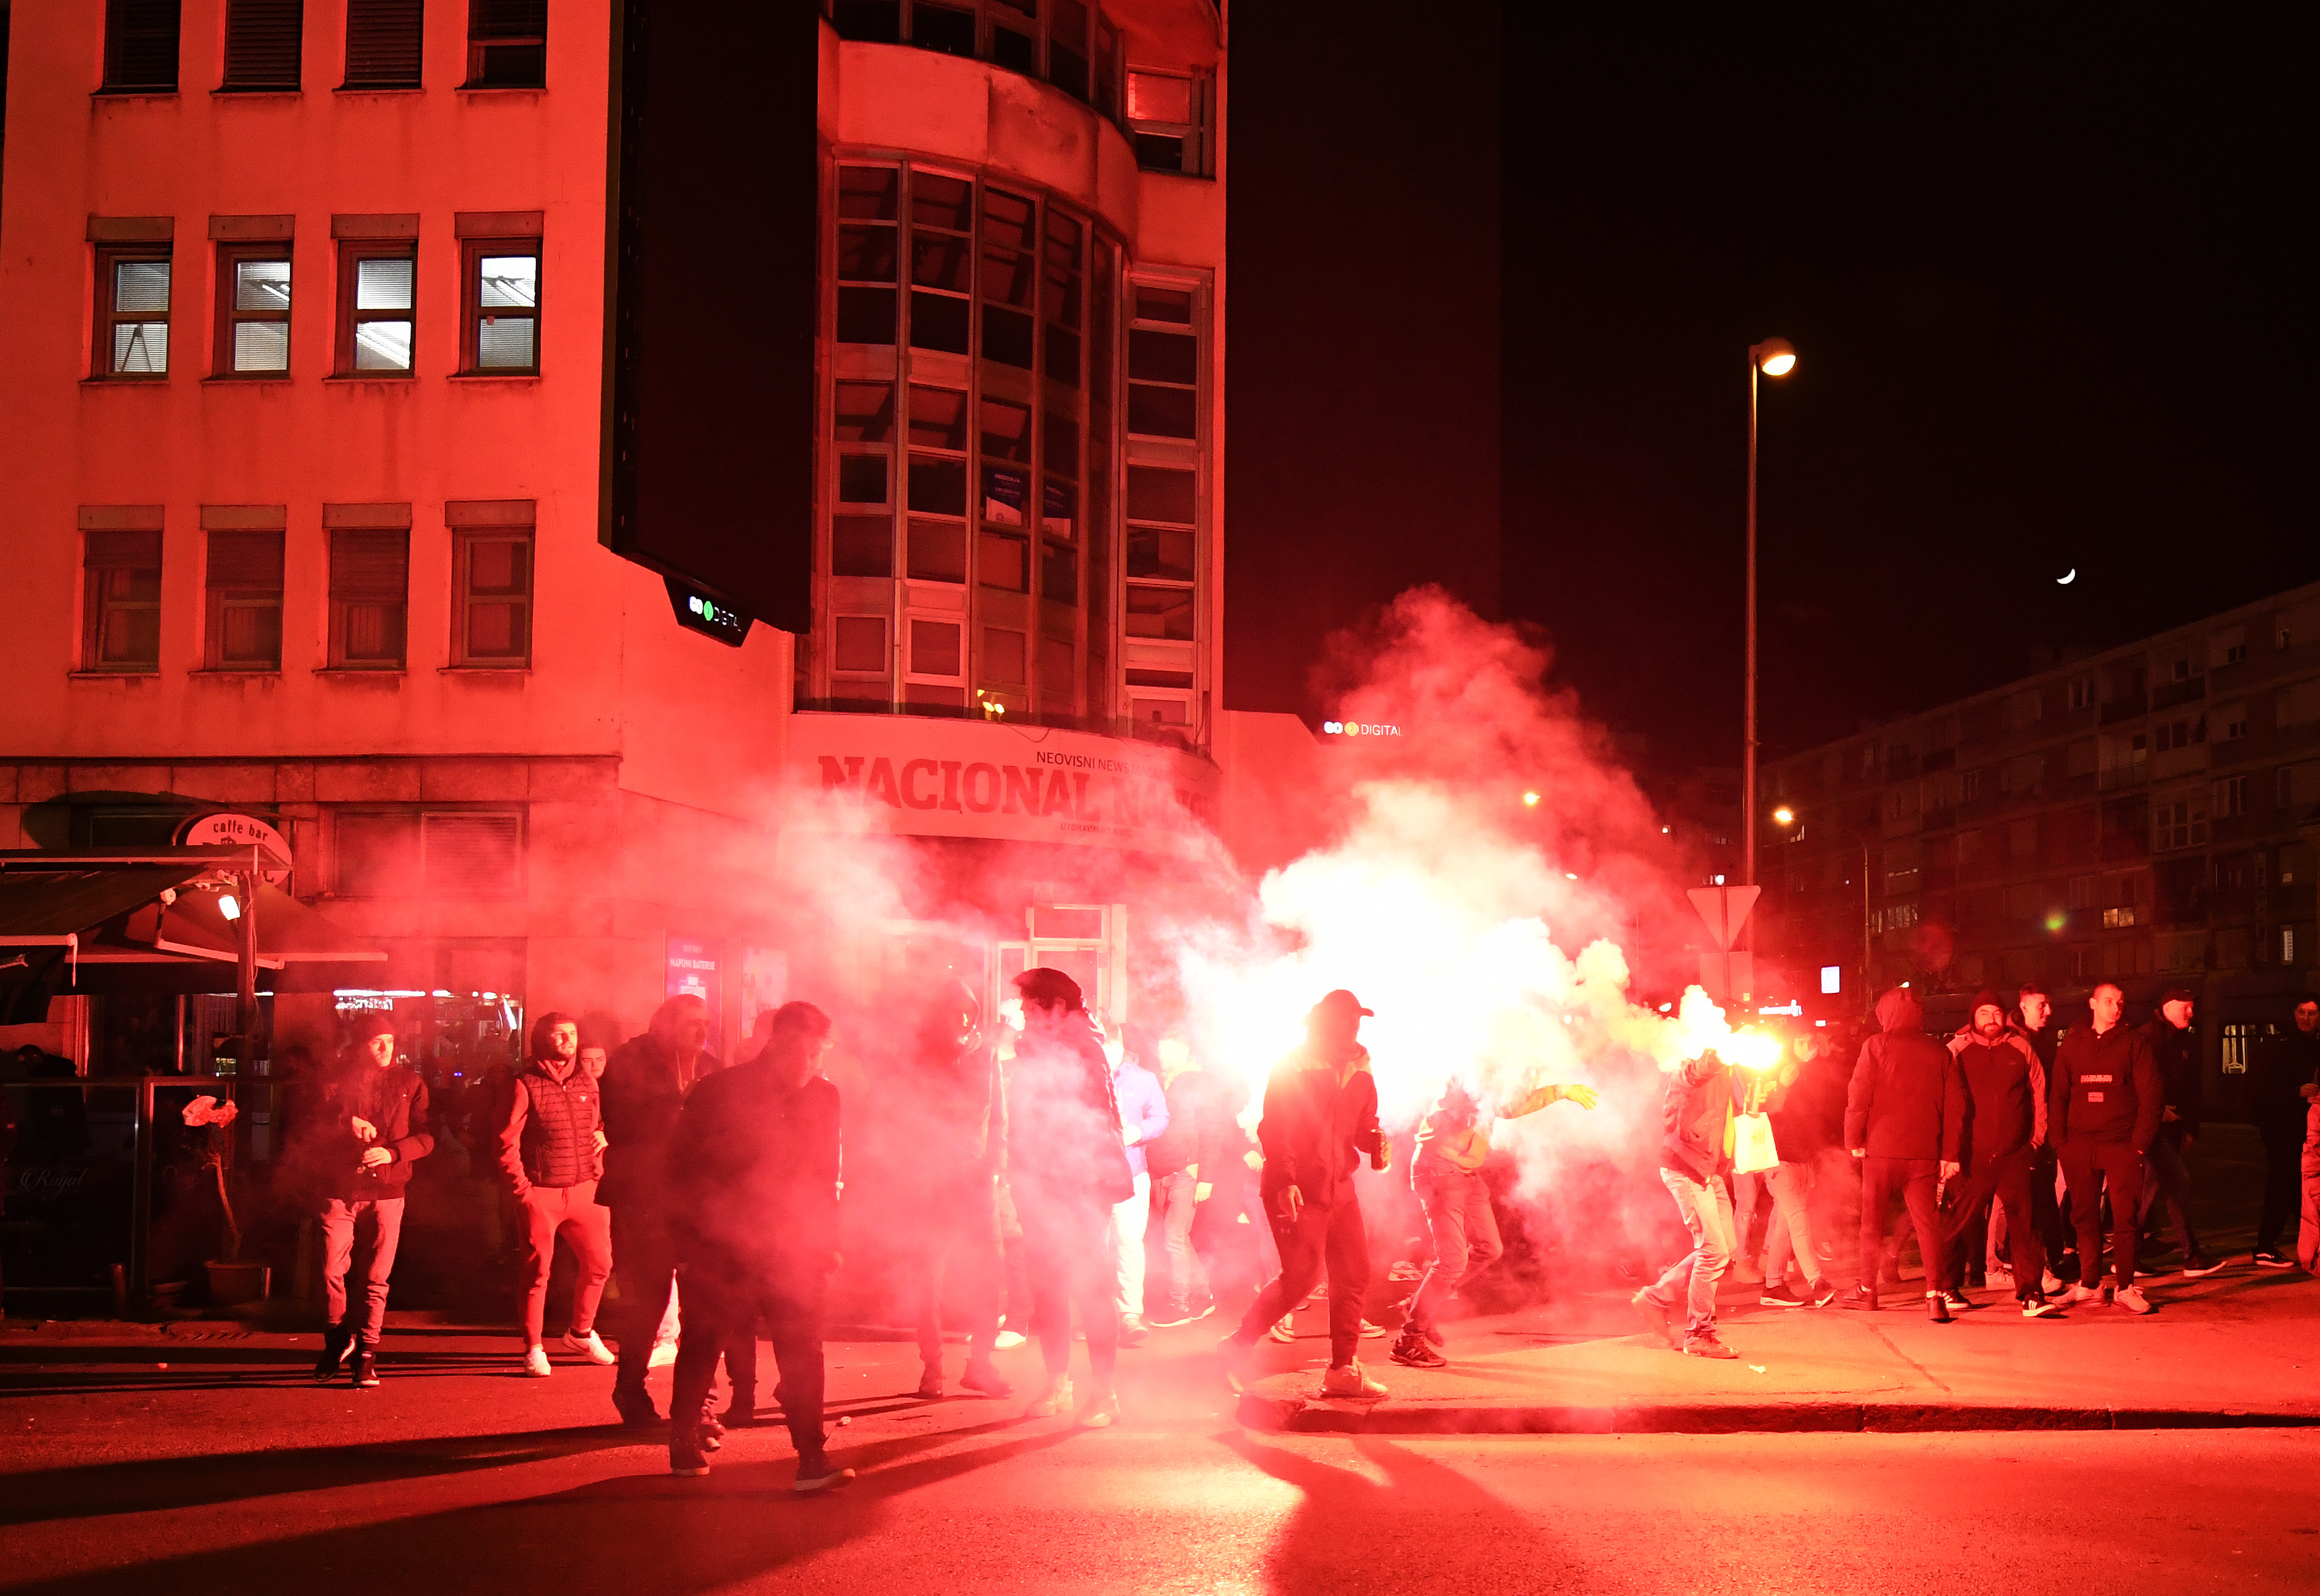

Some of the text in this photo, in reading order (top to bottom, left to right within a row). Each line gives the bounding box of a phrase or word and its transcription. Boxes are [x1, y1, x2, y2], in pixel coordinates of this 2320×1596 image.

[1036, 751, 1096, 770] NEOVISNI
[1098, 759, 1130, 775] NEWS
[819, 755, 1101, 822] NACIONAL
[213, 820, 268, 841] caffe bar
